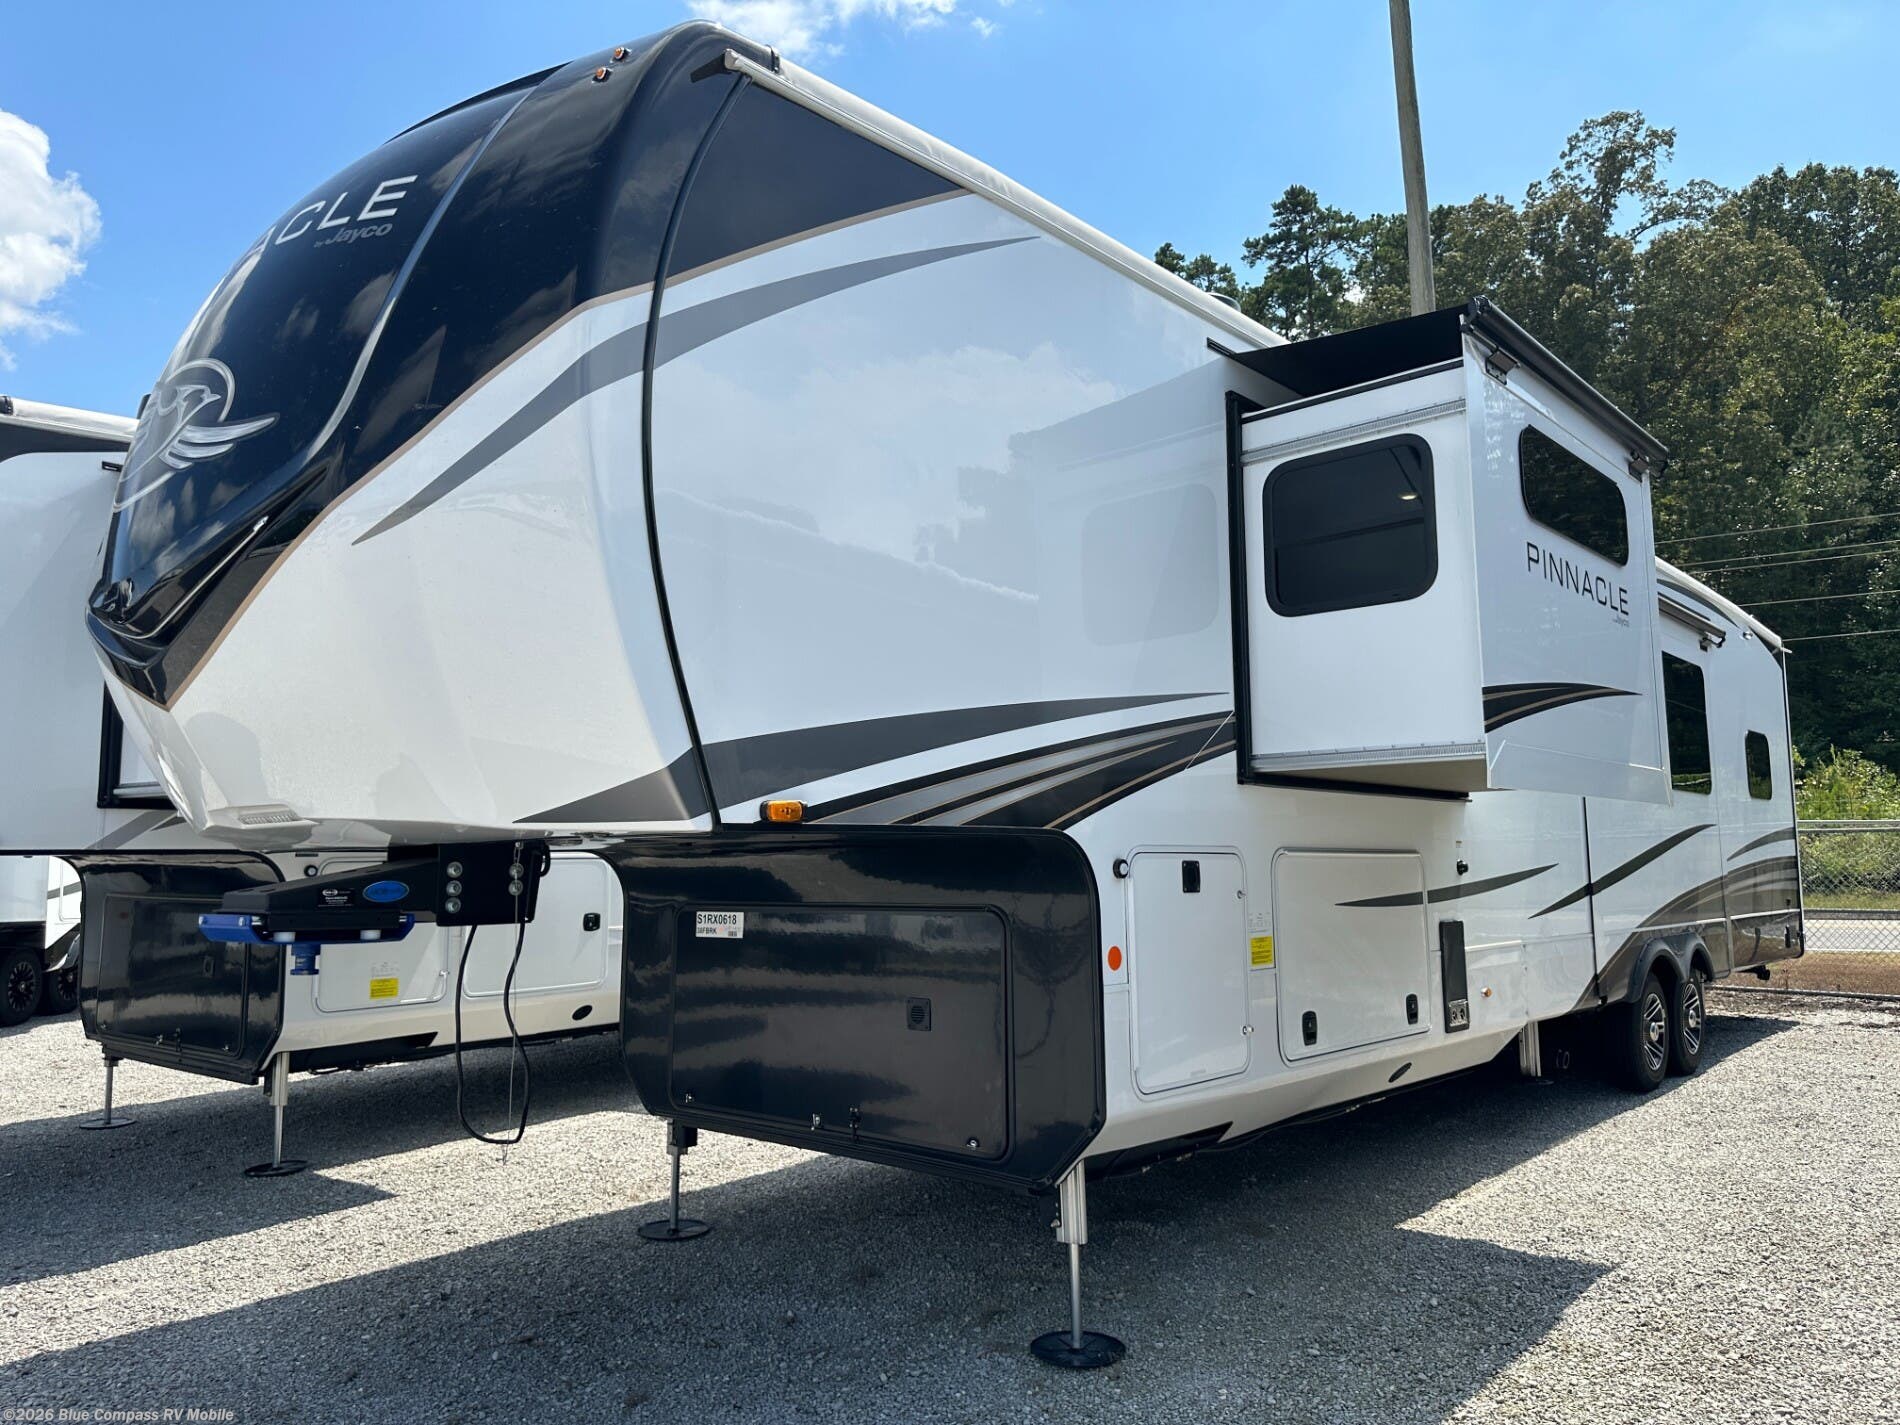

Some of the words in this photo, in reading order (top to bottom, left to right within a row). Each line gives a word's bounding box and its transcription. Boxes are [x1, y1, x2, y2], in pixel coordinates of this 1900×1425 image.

[325, 223, 393, 245] Jayco
[1526, 541, 1629, 616] PINNACLE
[697, 913, 737, 925] S1RX0618
